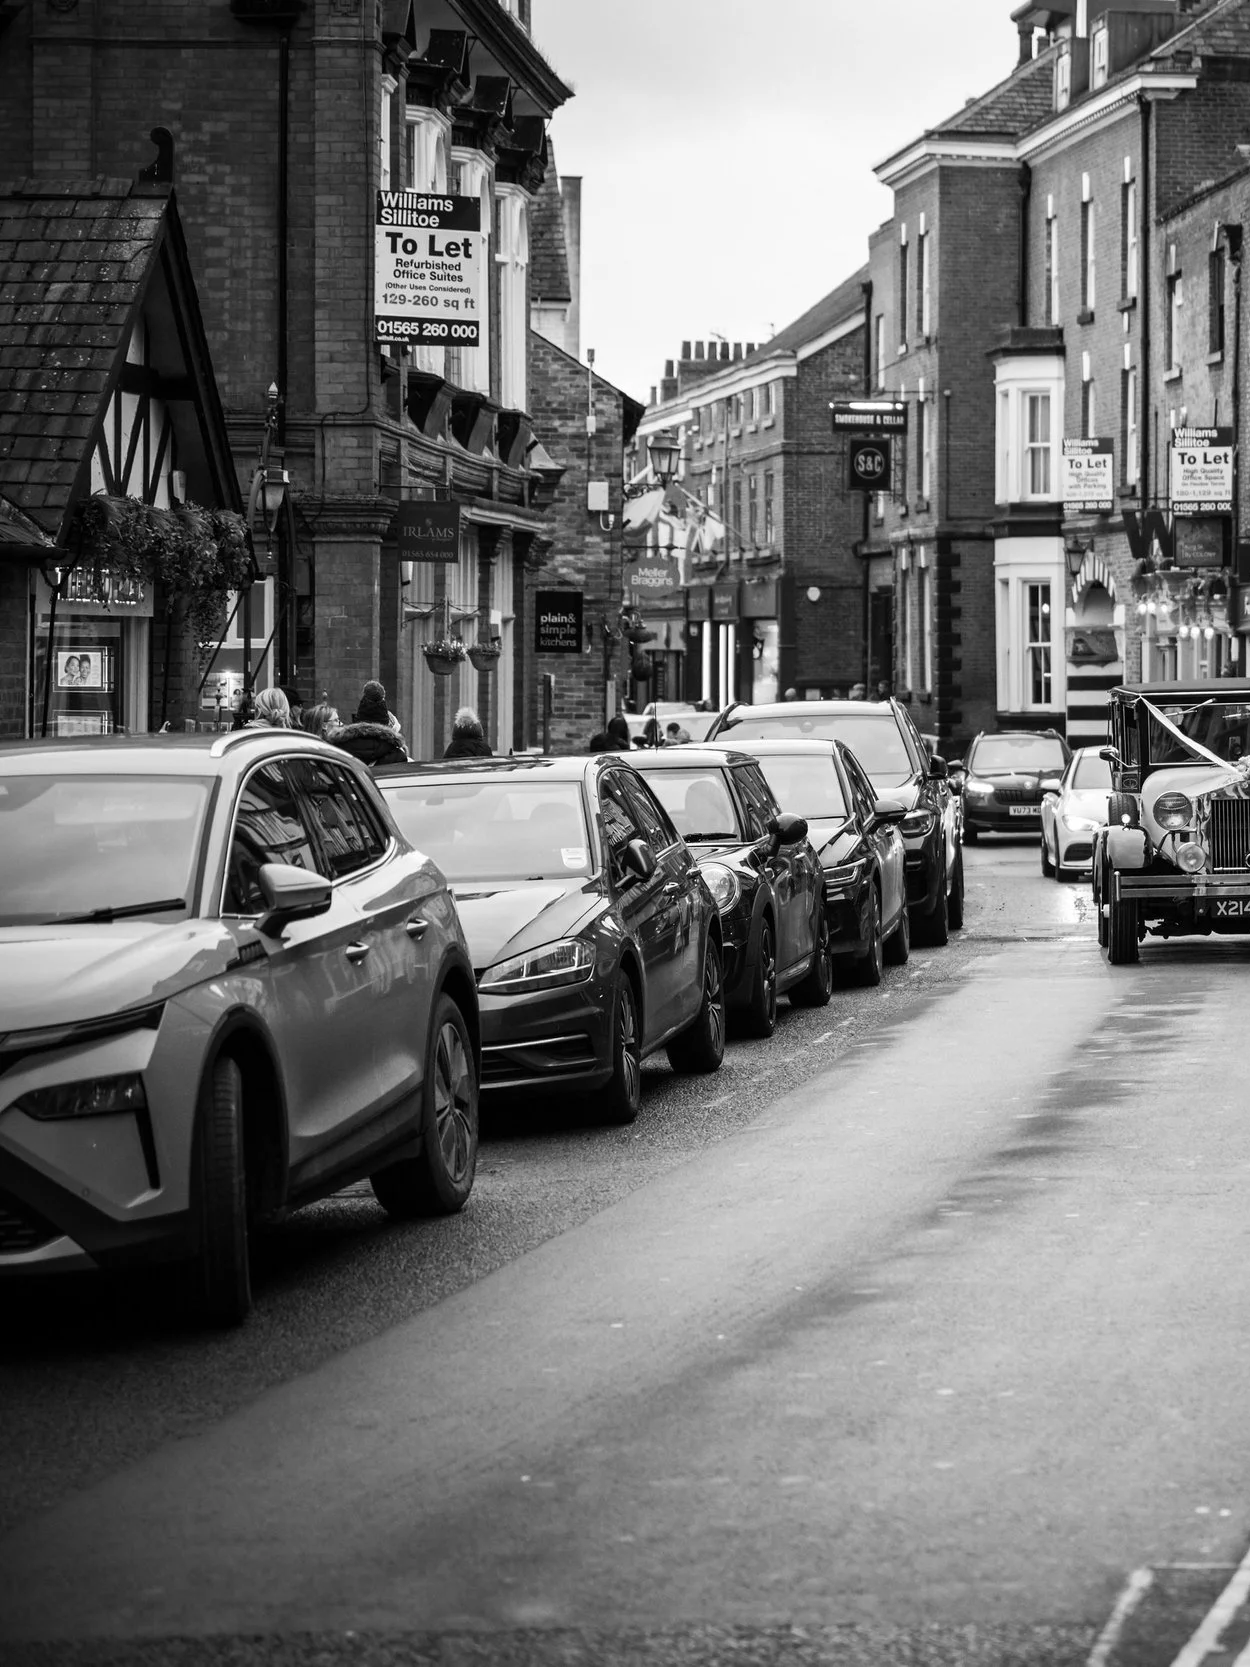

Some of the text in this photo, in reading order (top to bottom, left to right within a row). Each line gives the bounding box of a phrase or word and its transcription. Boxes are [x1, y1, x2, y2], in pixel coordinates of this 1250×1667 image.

[380, 191, 454, 212] Williams
[380, 208, 440, 227] Sillitoe
[385, 231, 473, 259] To Let
[395, 258, 461, 271] Refurbished
[393, 269, 464, 282] Office Suites
[385, 282, 471, 294] (Other Uses Considered)
[382, 293, 475, 310] 129-260 sq ft
[377, 320, 477, 338] 01565 260 000
[882, 415, 905, 425] CELLAR
[1174, 427, 1218, 438] Williams
[1174, 437, 1210, 448] Sillitoe
[858, 454, 881, 472] S&C
[1068, 458, 1107, 469] To Let
[1178, 452, 1229, 465] To Let
[403, 526, 454, 538] IRLAMS
[638, 567, 669, 577] Meller
[631, 575, 673, 587] Braggins
[540, 624, 577, 639] simple
[541, 636, 577, 646] kitchens
